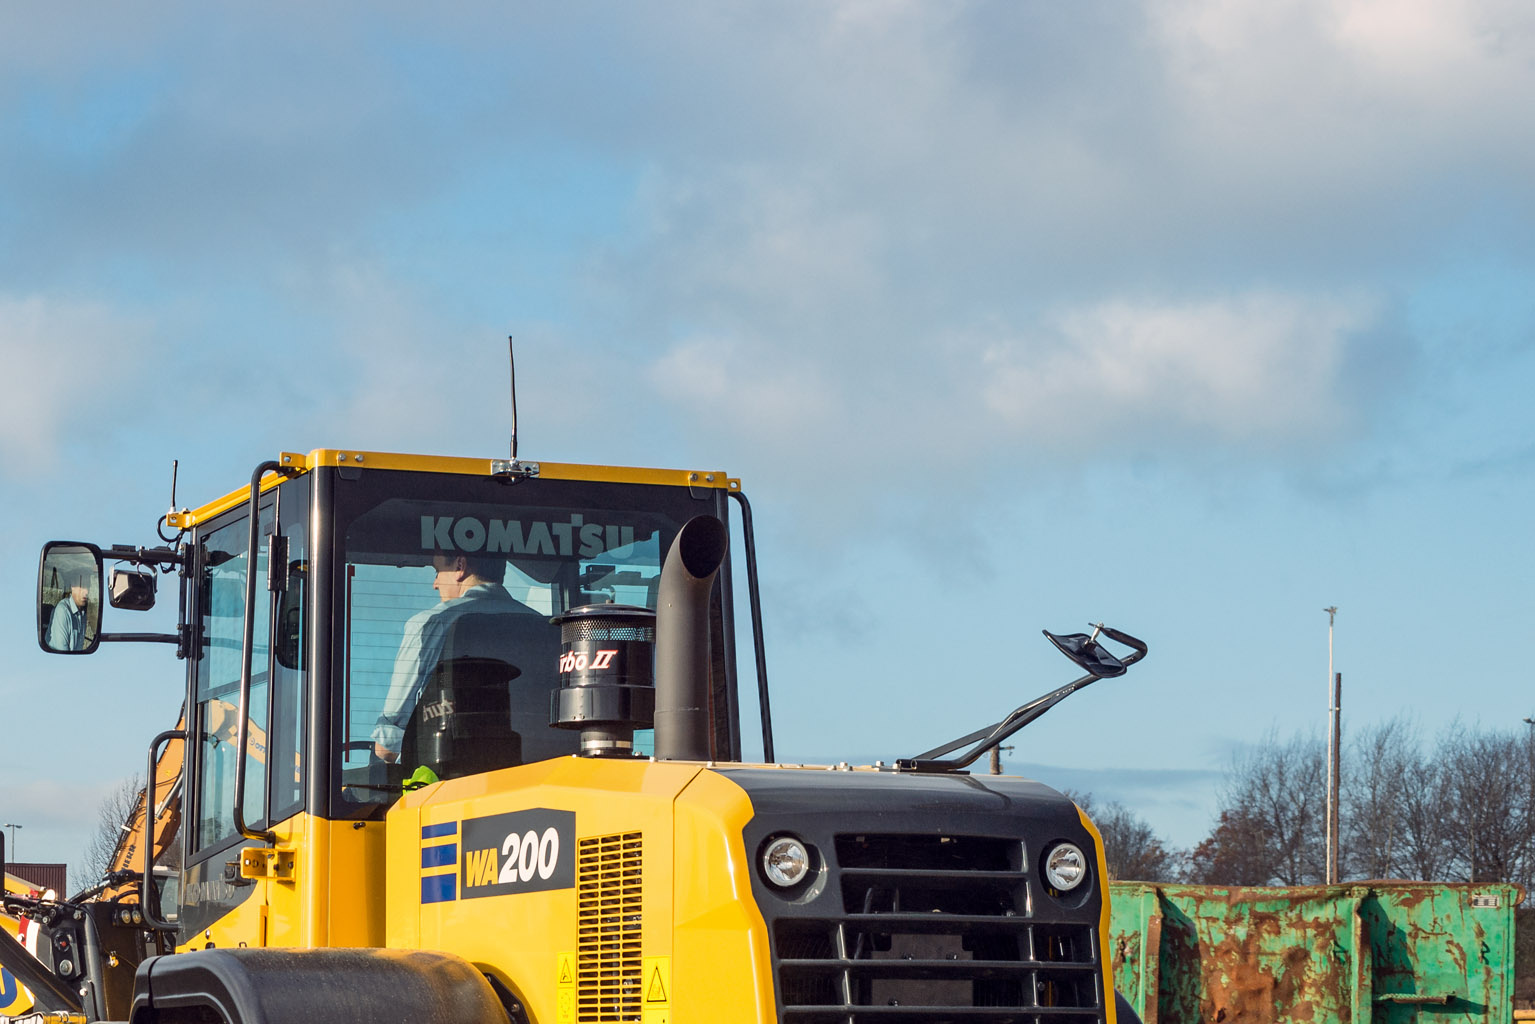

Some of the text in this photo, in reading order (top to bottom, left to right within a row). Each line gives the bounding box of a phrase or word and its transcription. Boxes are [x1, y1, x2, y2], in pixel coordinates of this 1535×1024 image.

[420, 513, 635, 560] KOMATSU
[589, 649, 619, 670] II
[465, 827, 560, 888] WA200
